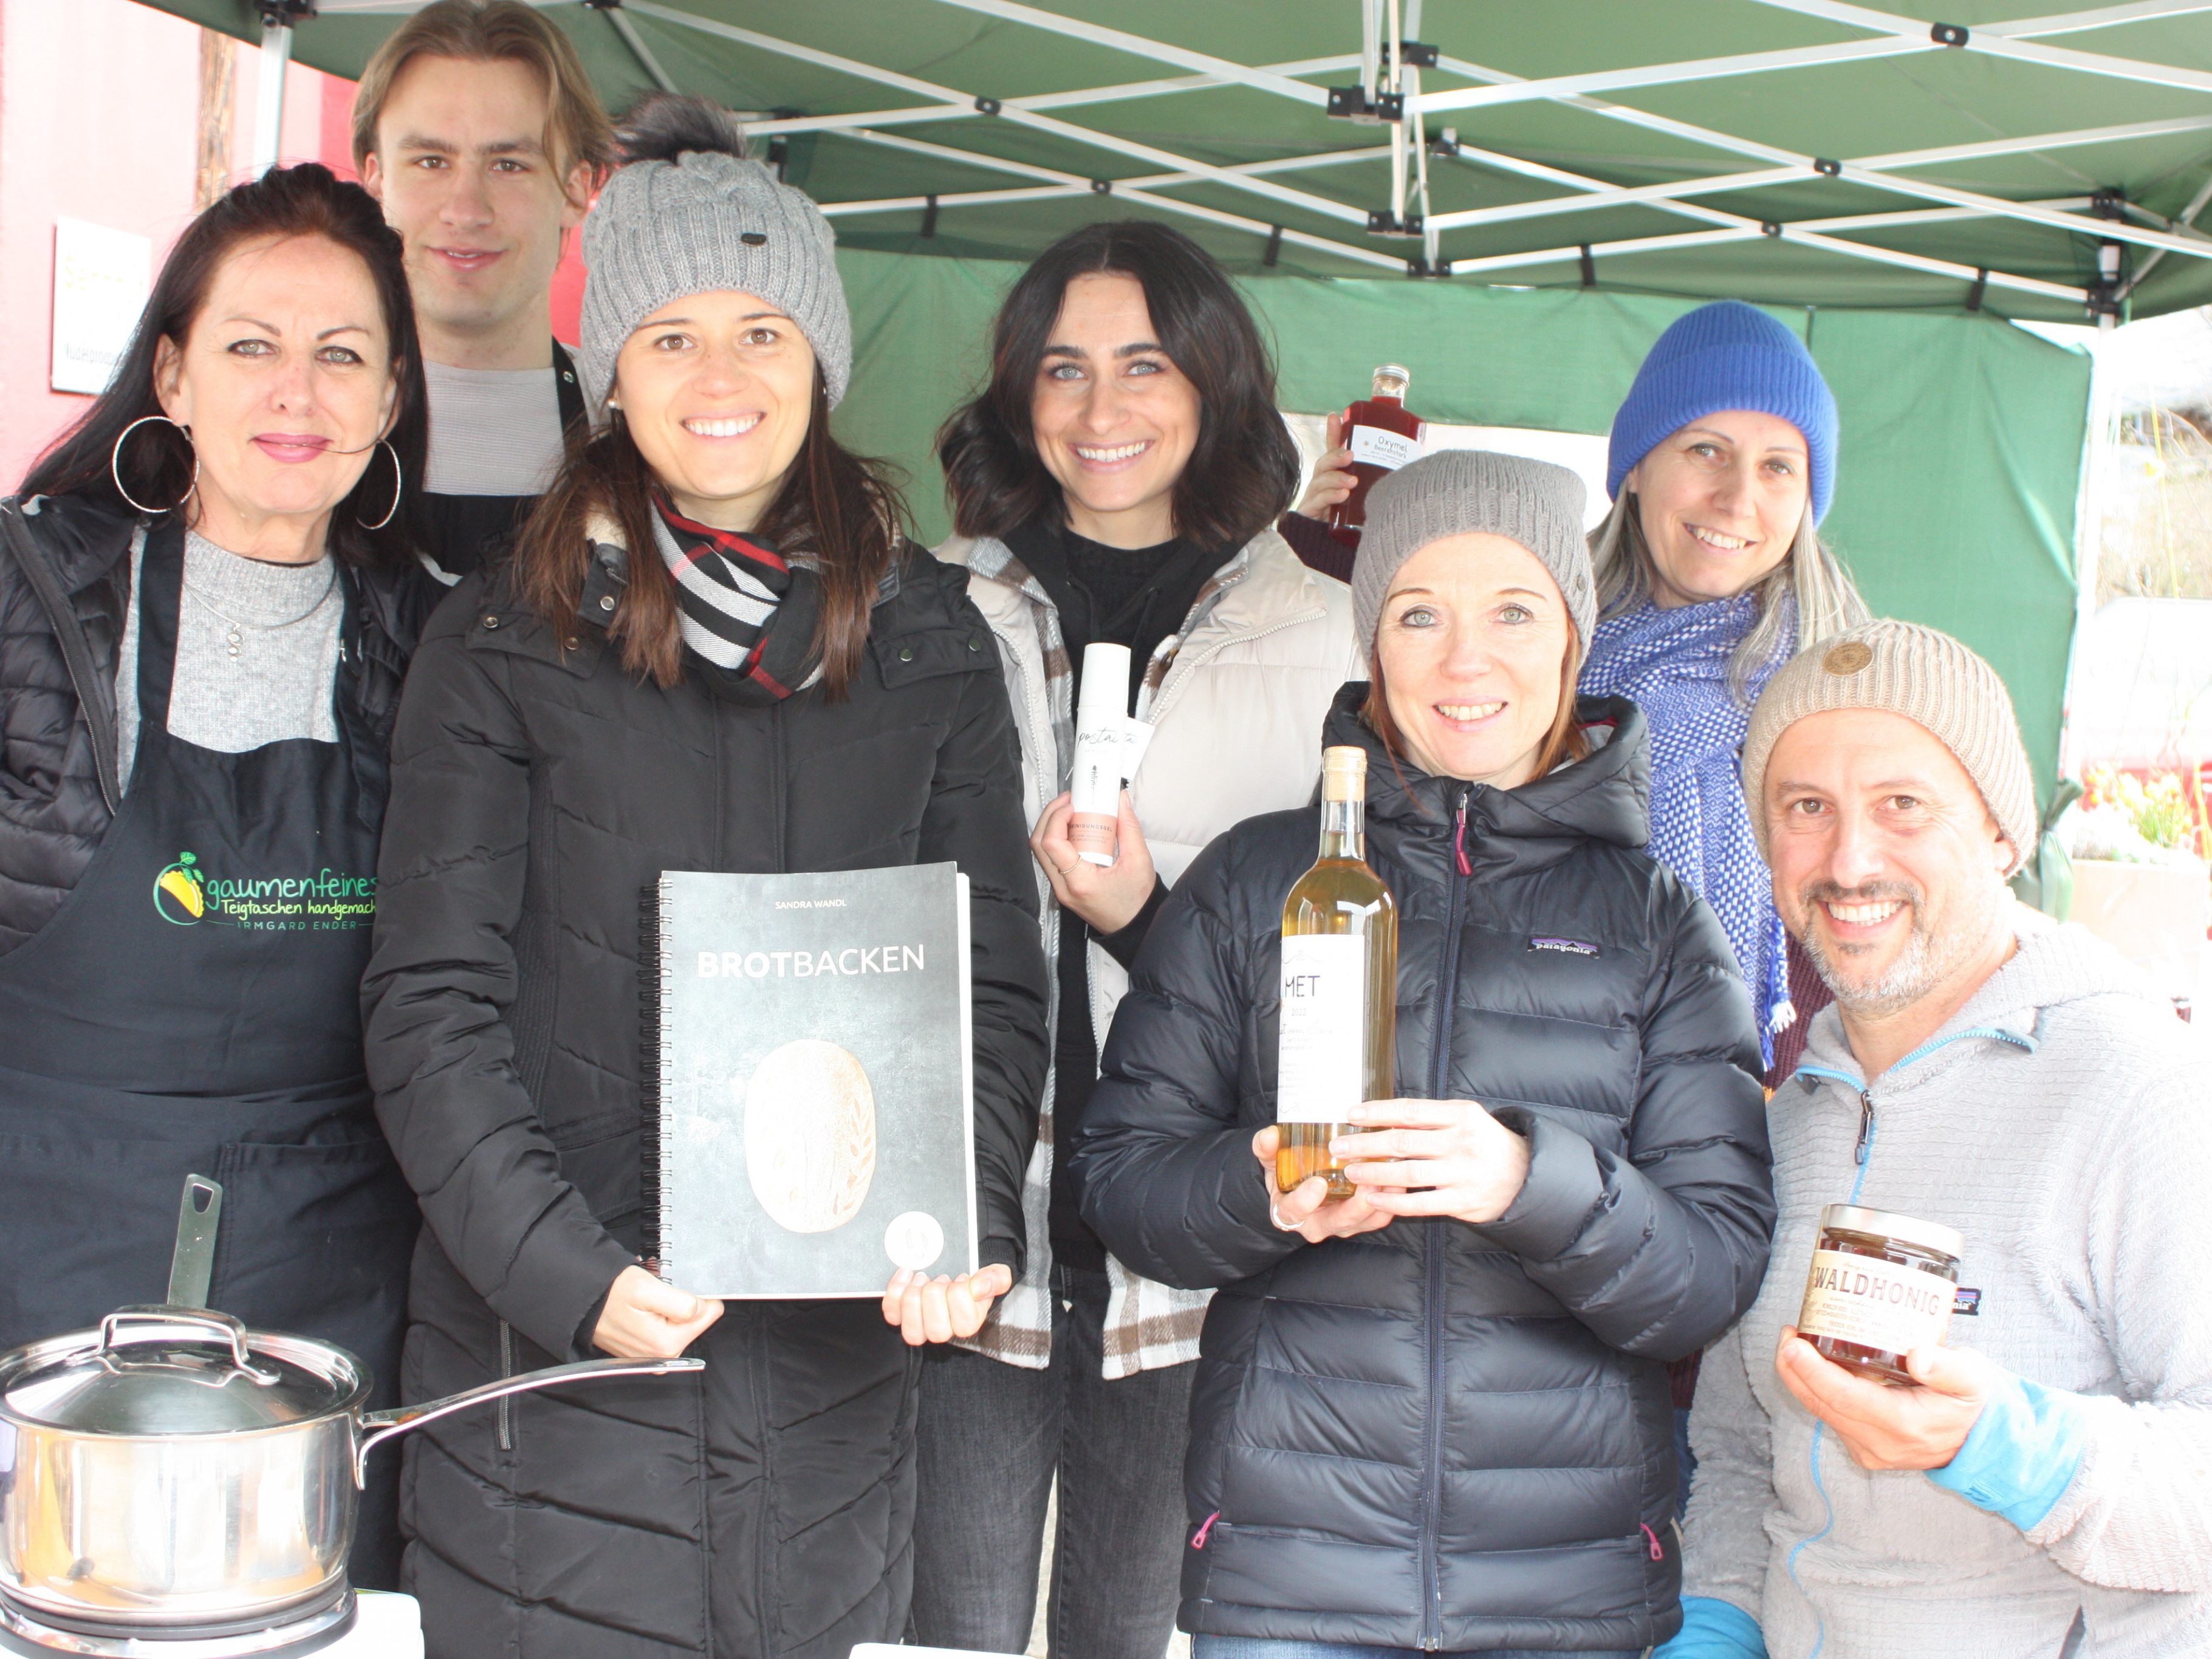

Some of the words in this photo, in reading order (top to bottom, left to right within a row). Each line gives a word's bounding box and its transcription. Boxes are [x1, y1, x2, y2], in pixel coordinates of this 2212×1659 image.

[1378, 436, 1408, 453] Oxymel
[205, 867, 378, 910] gaumenfeines
[221, 899, 302, 920] Teigtaschen
[775, 901, 813, 909] SANDRA
[813, 898, 847, 908] WANDL
[238, 921, 306, 931] IRMGARD
[313, 920, 357, 930] ENDER
[1536, 943, 1592, 955] patagonia
[697, 944, 925, 979] BROTBACKEN
[1284, 975, 1321, 997] MET
[1291, 1008, 1307, 1017] 2022
[1815, 1267, 1940, 1316] WALDHONIG
